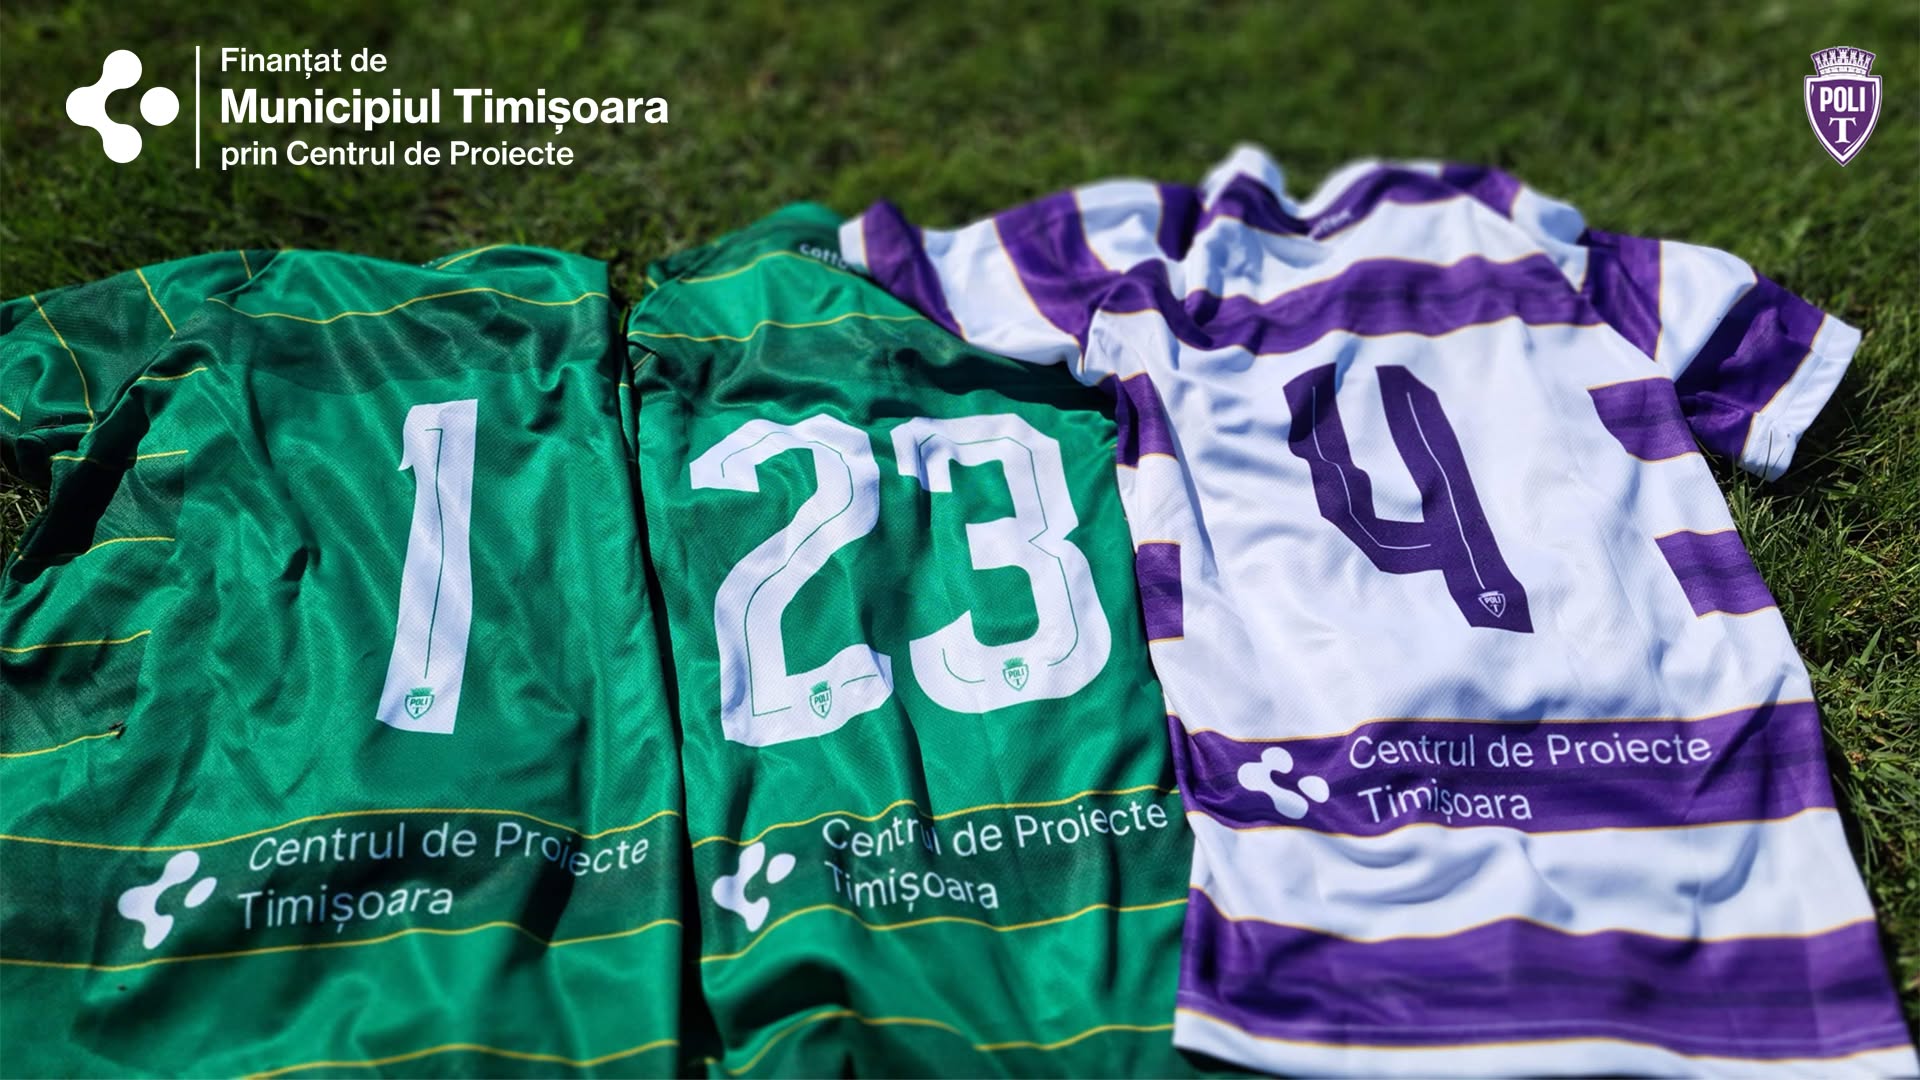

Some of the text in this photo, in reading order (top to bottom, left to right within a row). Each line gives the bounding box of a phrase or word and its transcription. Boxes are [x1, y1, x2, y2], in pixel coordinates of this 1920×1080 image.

[1283, 362, 1535, 633] 4
[375, 399, 478, 734] 1
[689, 413, 1112, 747] 23
[1349, 732, 1712, 769] Centrul de Proiecte
[1358, 778, 1533, 823] Timișoara
[248, 821, 649, 876] Centrul de Proiecte
[822, 801, 1168, 857] Centrul de Proiecte
[238, 885, 453, 933] Timișoara
[825, 861, 999, 912] Timișoara
